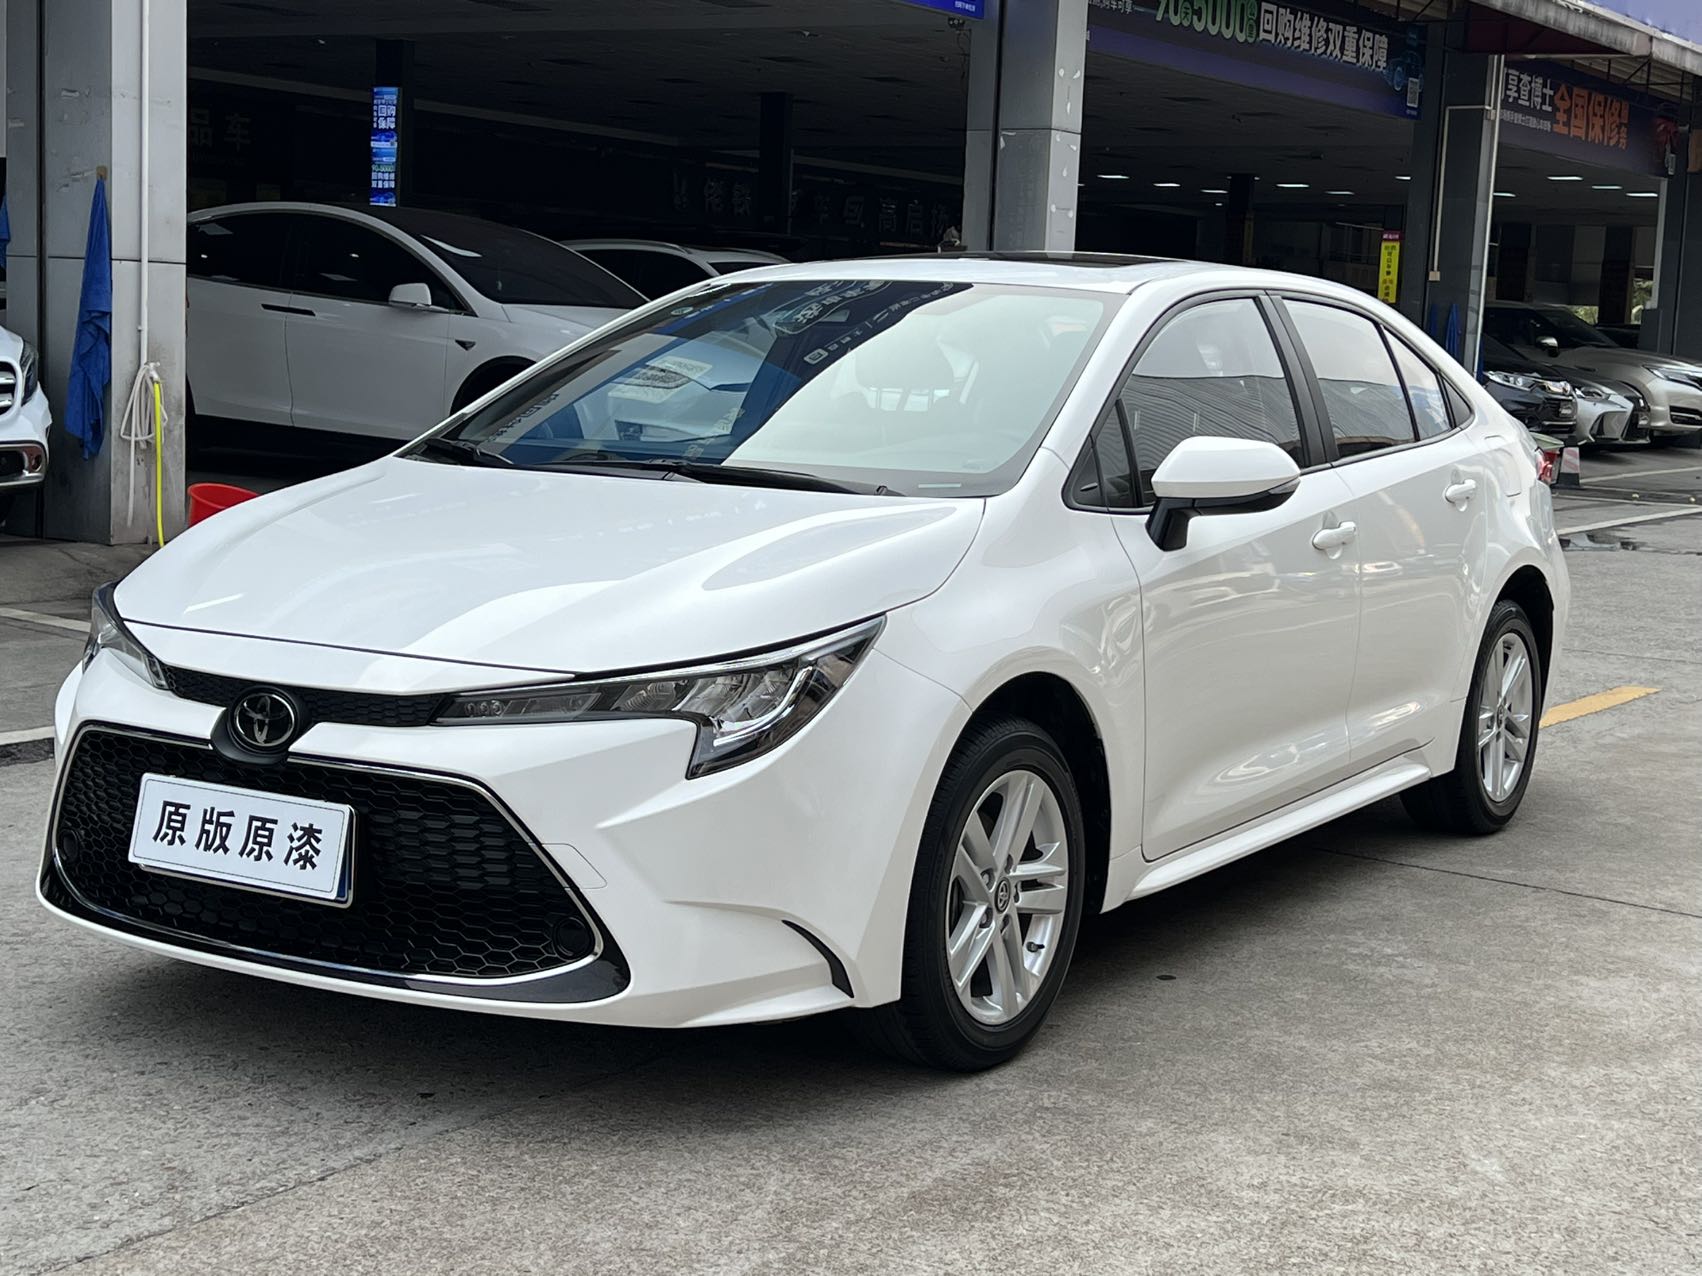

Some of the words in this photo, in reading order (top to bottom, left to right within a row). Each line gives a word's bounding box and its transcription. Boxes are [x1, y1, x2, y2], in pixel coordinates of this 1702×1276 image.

[1259, 2, 1388, 72] 回购维修双重保障
[152, 800, 323, 871] 原版原漆
